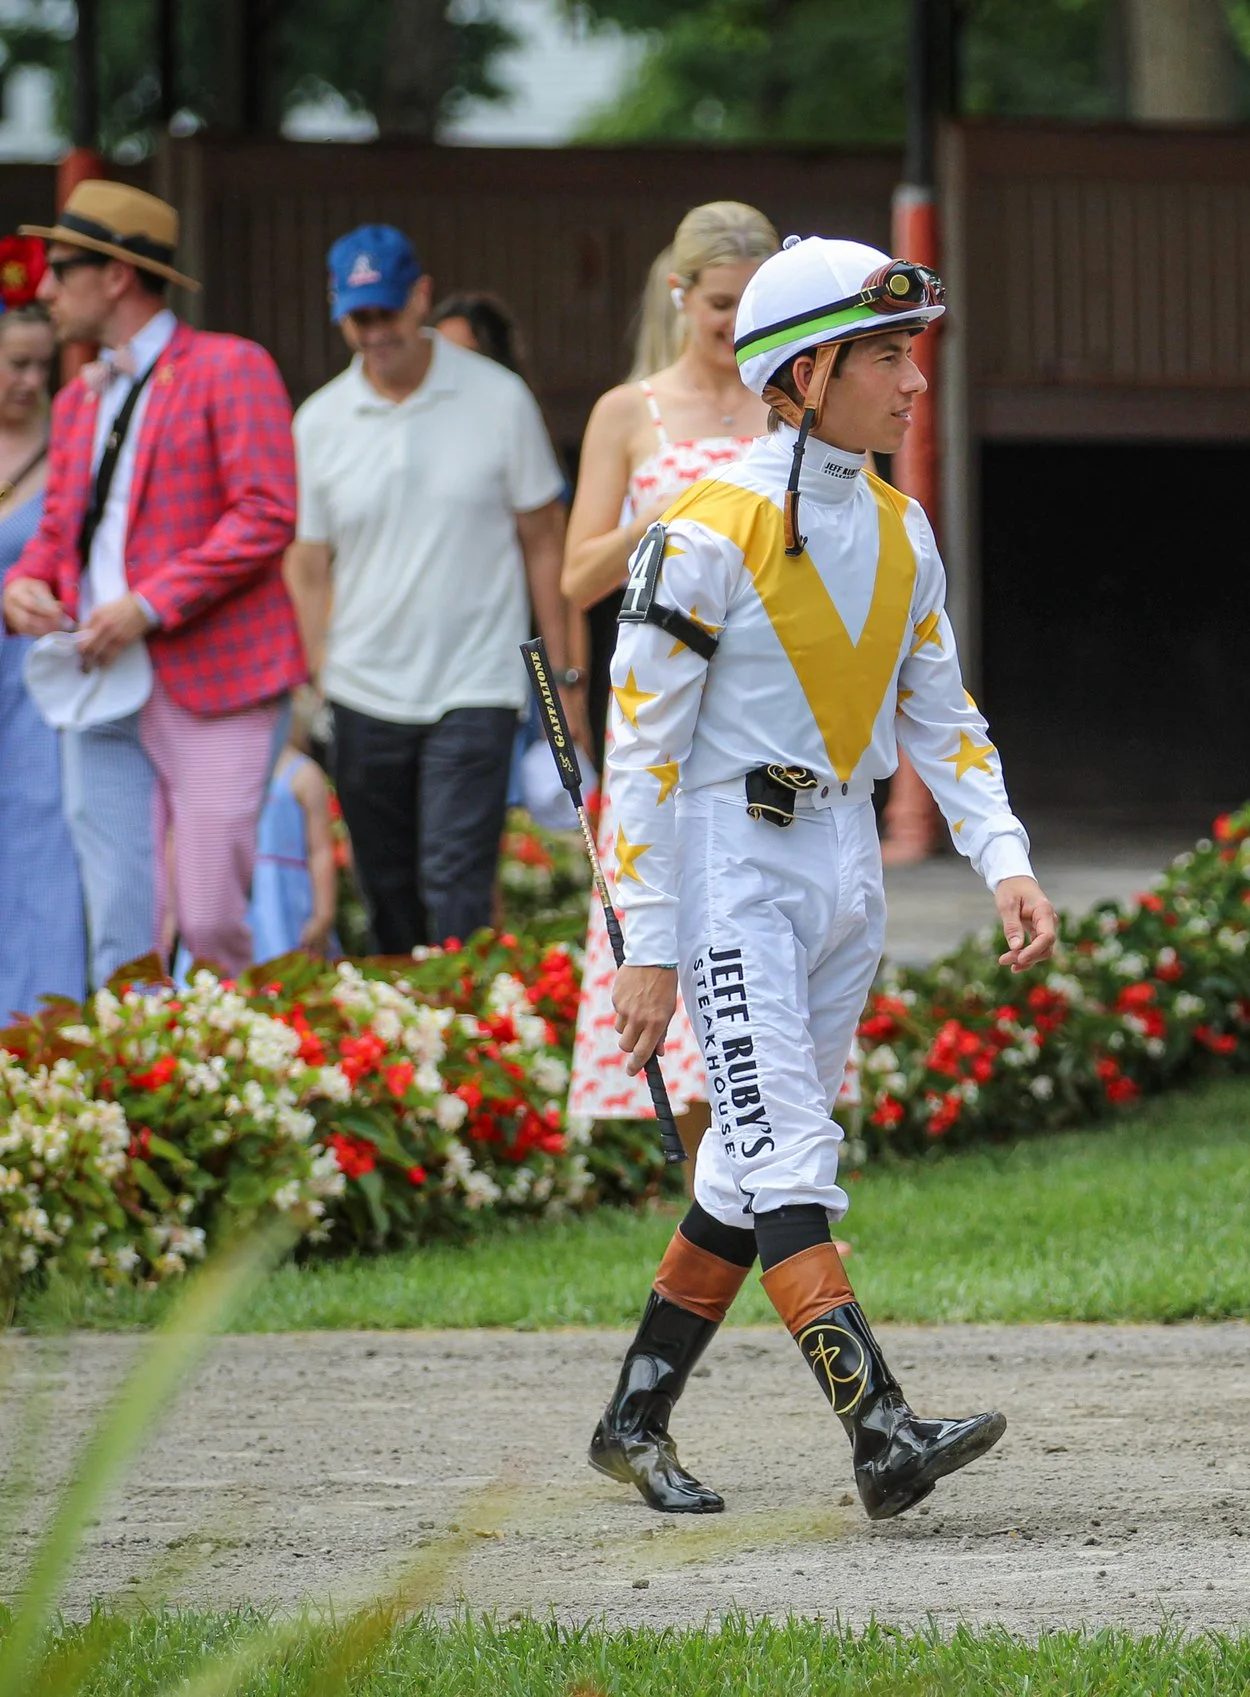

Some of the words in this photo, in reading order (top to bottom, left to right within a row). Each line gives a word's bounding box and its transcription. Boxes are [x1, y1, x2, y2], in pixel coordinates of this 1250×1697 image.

[825, 462, 843, 473] JEFF
[627, 540, 656, 612] 4
[530, 651, 565, 749] GAFFALIONE
[709, 946, 750, 1022] JEFF
[694, 958, 735, 1155] STEAKHOUSE
[722, 1034, 775, 1159] RUBY'S
